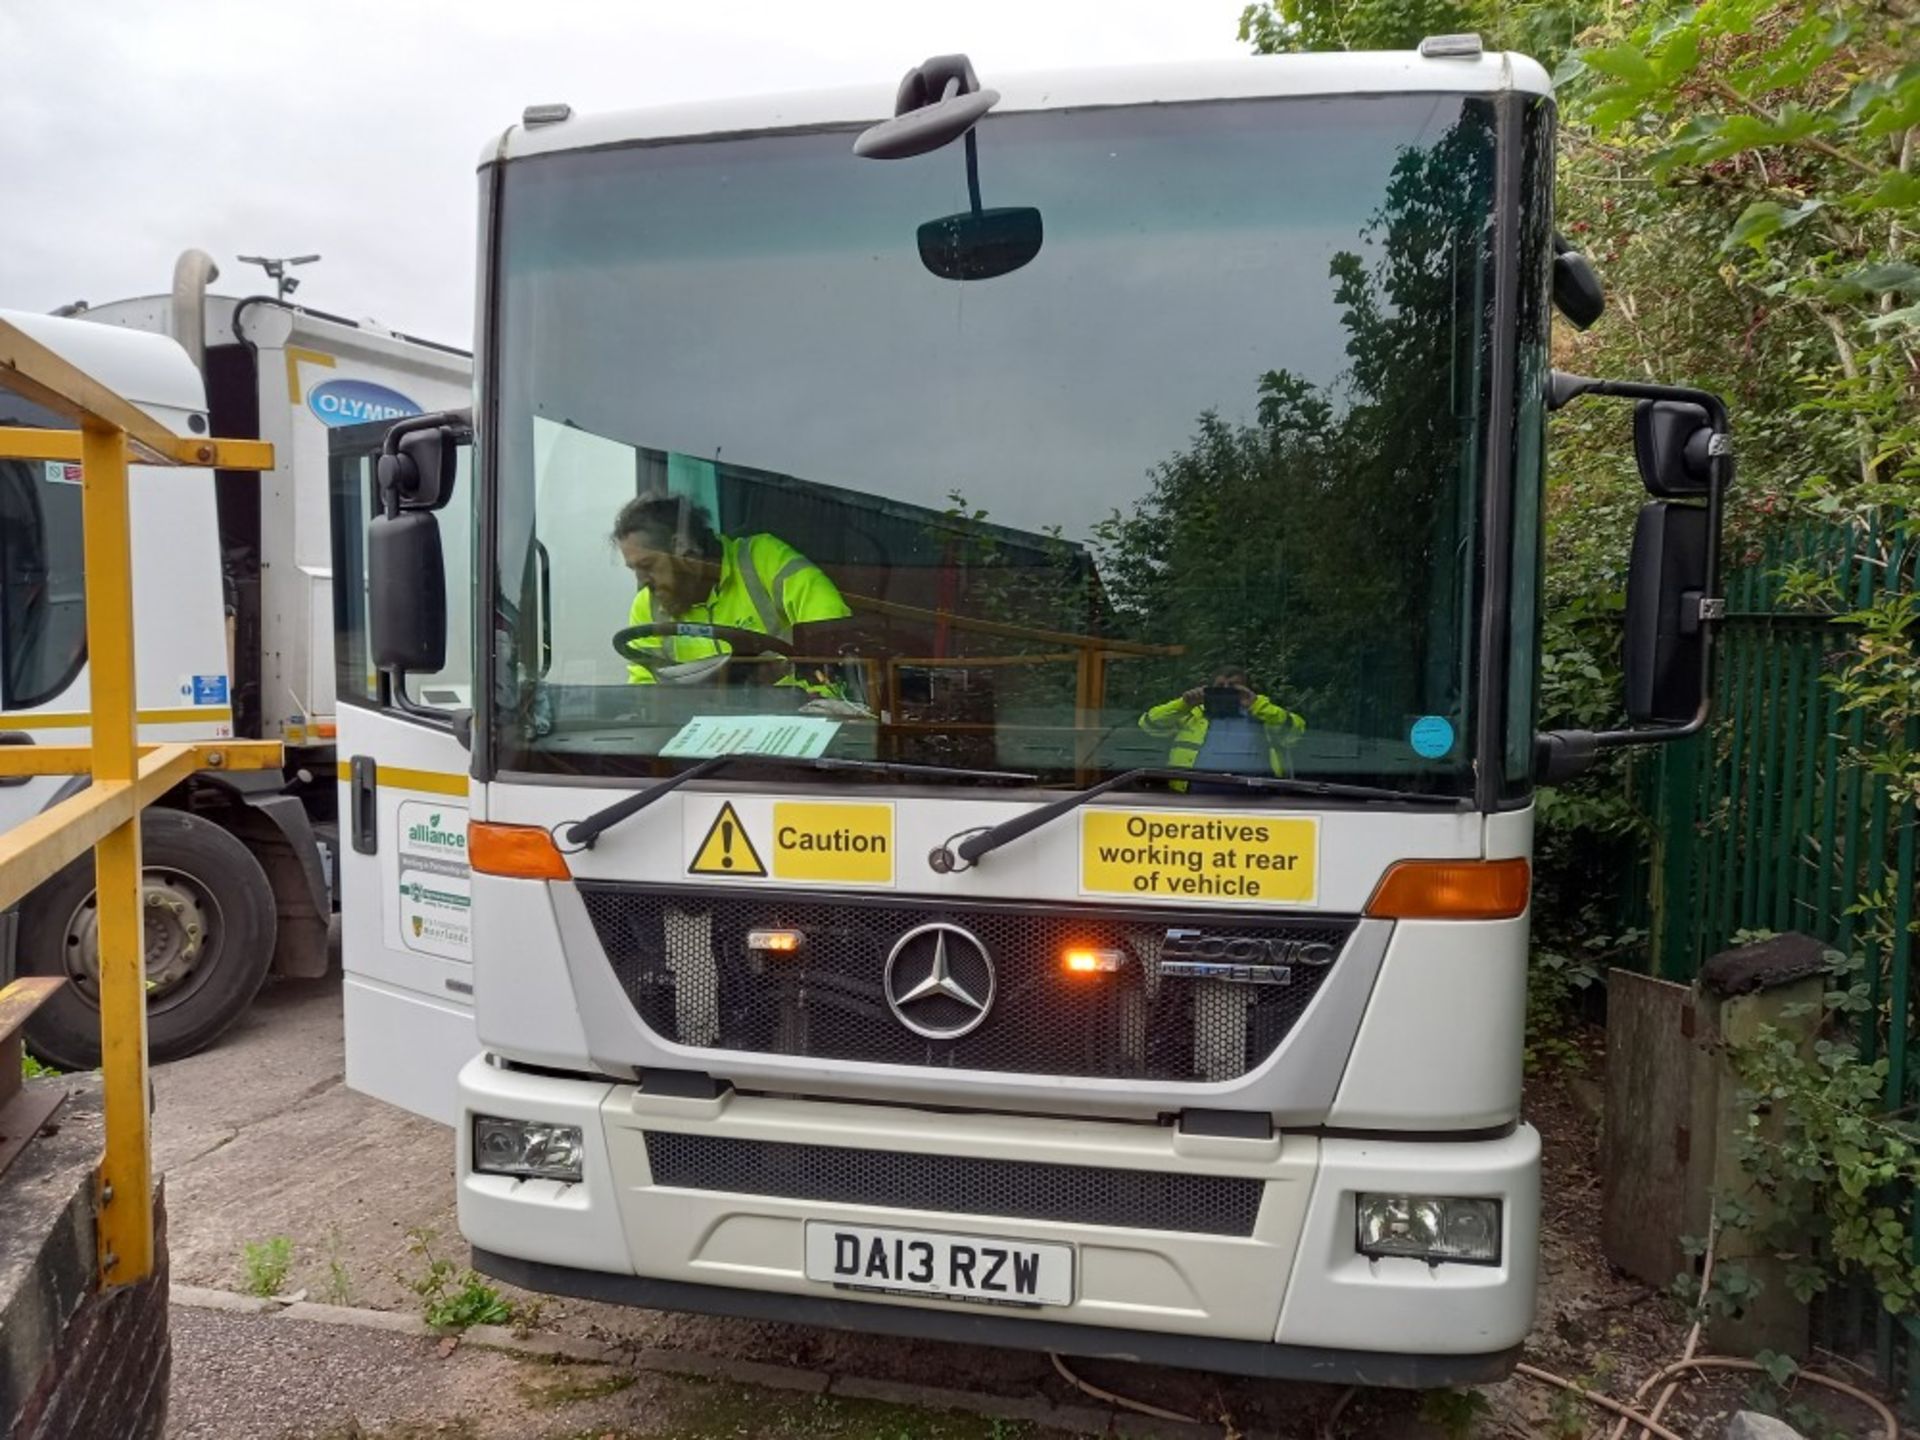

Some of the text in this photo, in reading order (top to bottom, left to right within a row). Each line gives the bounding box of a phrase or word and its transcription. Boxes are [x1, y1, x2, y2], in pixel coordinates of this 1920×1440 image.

[409, 823, 465, 848] alliance
[777, 826, 887, 853] Caution
[1126, 816, 1270, 842] Operatives
[1098, 844, 1299, 872] working at rear
[1133, 871, 1261, 896] of vehicle
[1160, 928, 1335, 966] ECONIC
[834, 1232, 935, 1284] DA13
[950, 1244, 1041, 1296] RZW
